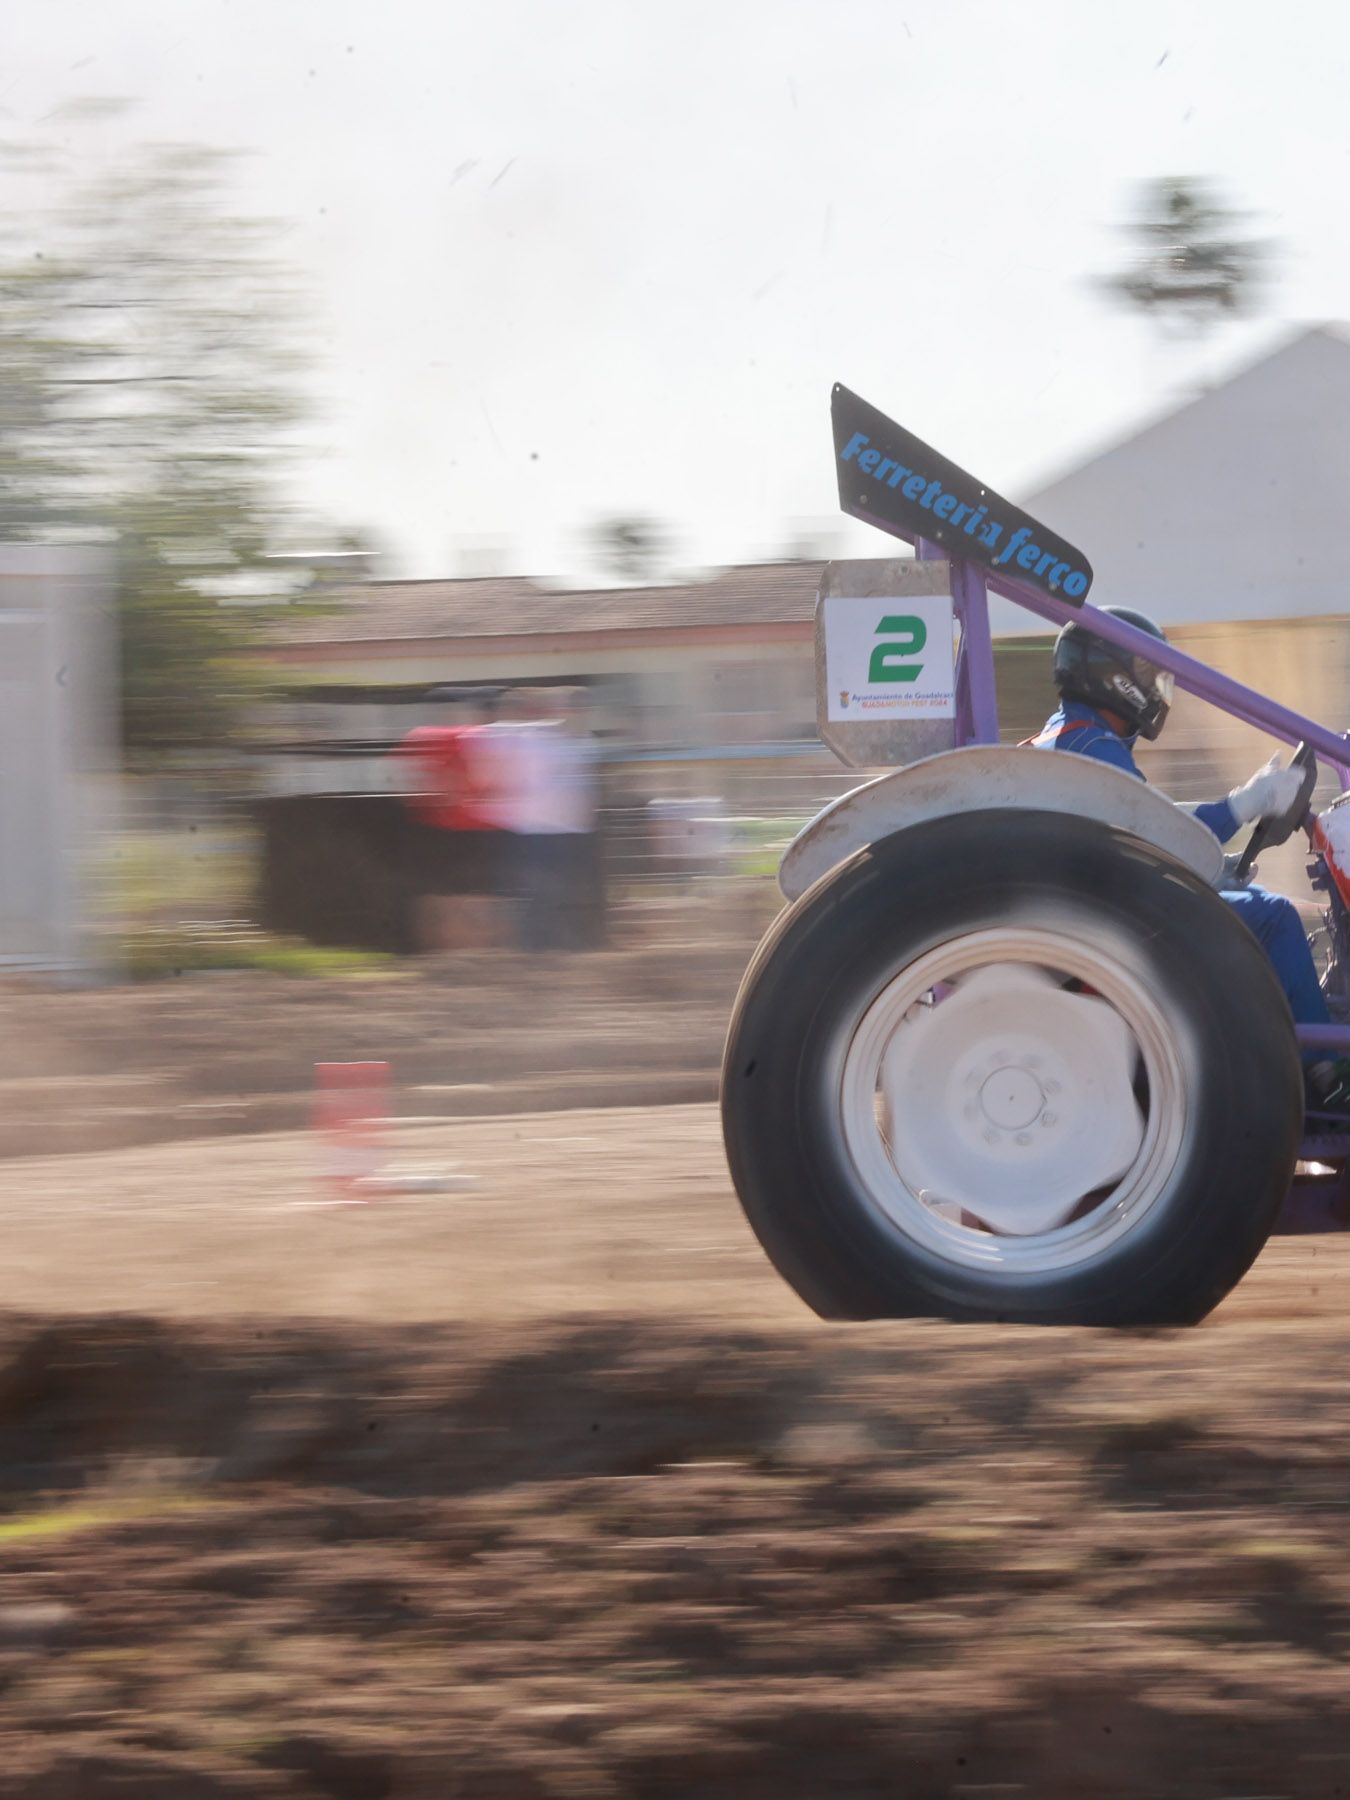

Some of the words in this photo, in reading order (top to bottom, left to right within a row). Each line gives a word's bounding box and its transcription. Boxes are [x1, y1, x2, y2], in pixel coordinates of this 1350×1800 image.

[840, 431, 1004, 548] Ferreteria
[996, 527, 1088, 597] ferco
[868, 615, 927, 683] 2
